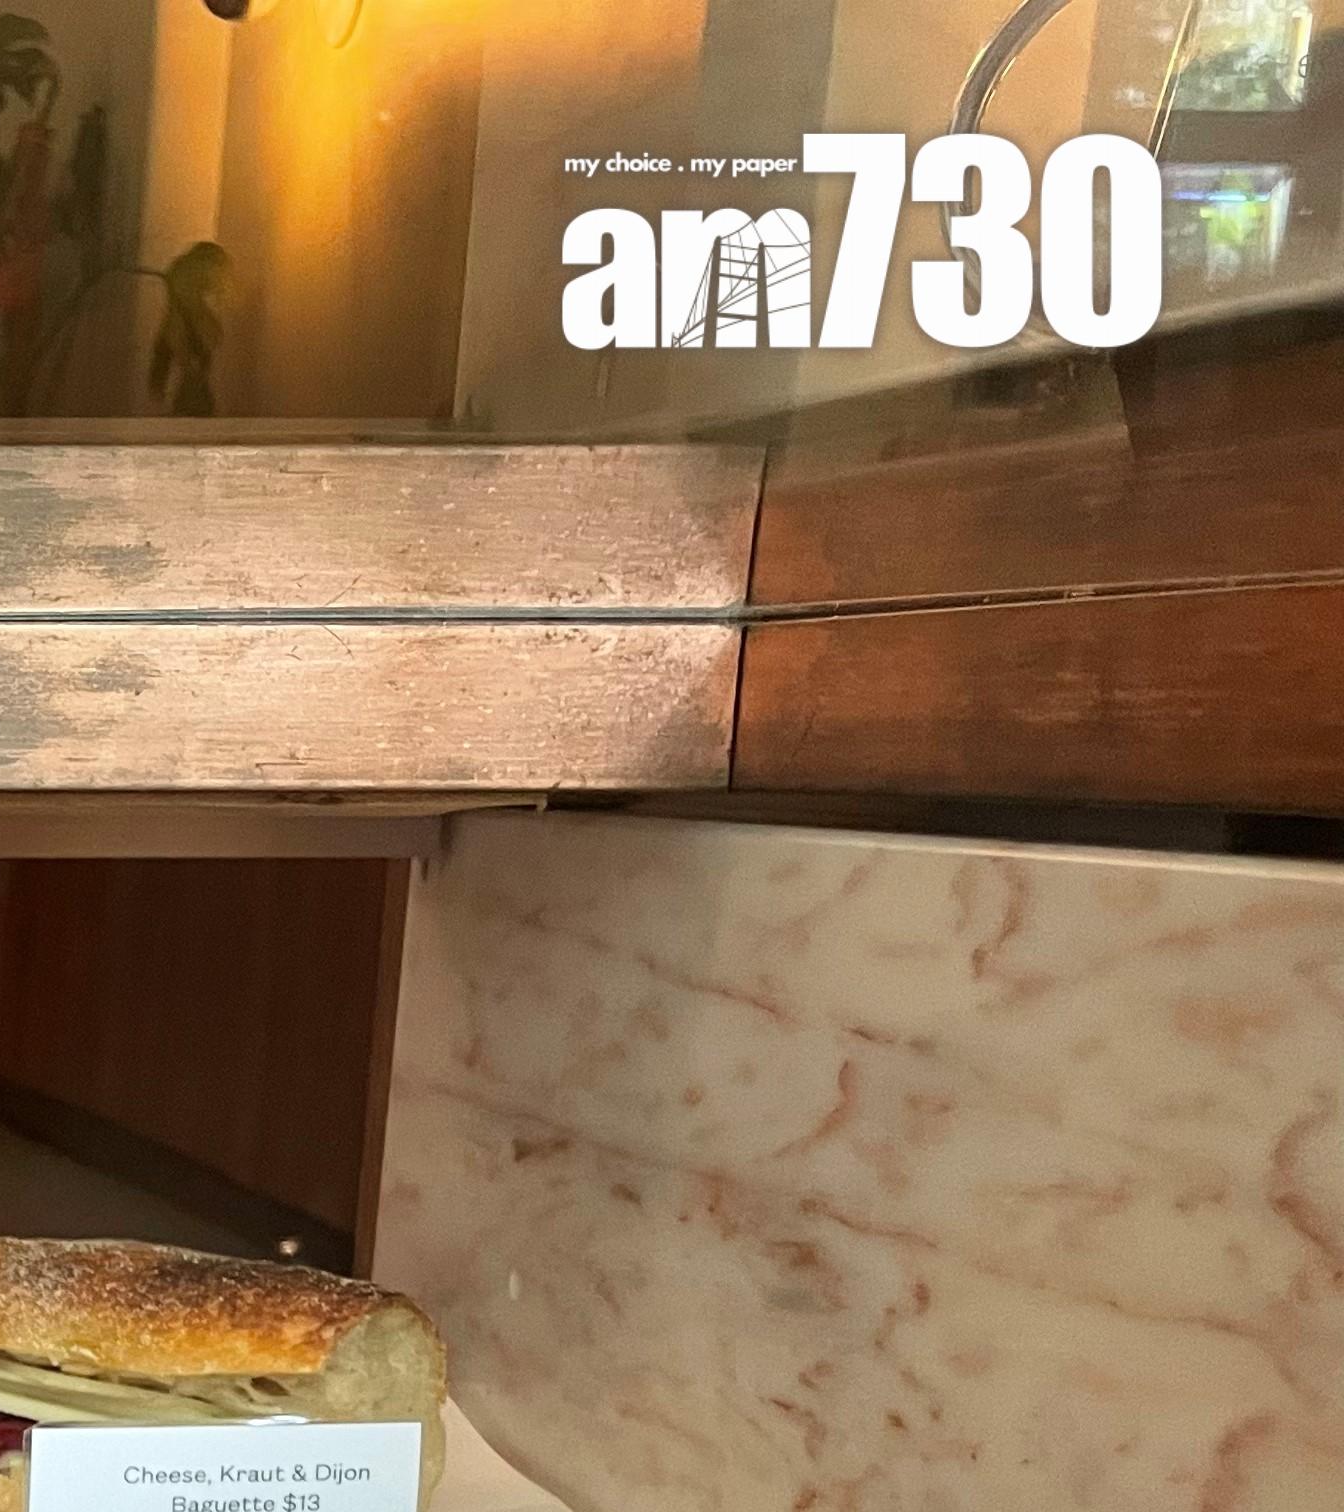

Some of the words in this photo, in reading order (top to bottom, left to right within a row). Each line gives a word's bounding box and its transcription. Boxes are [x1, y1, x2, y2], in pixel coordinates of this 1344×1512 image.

[123, 1465, 212, 1486] Cheese,
[220, 1464, 285, 1483] Kraut
[291, 1464, 307, 1483] &
[315, 1462, 371, 1486] Dijon
